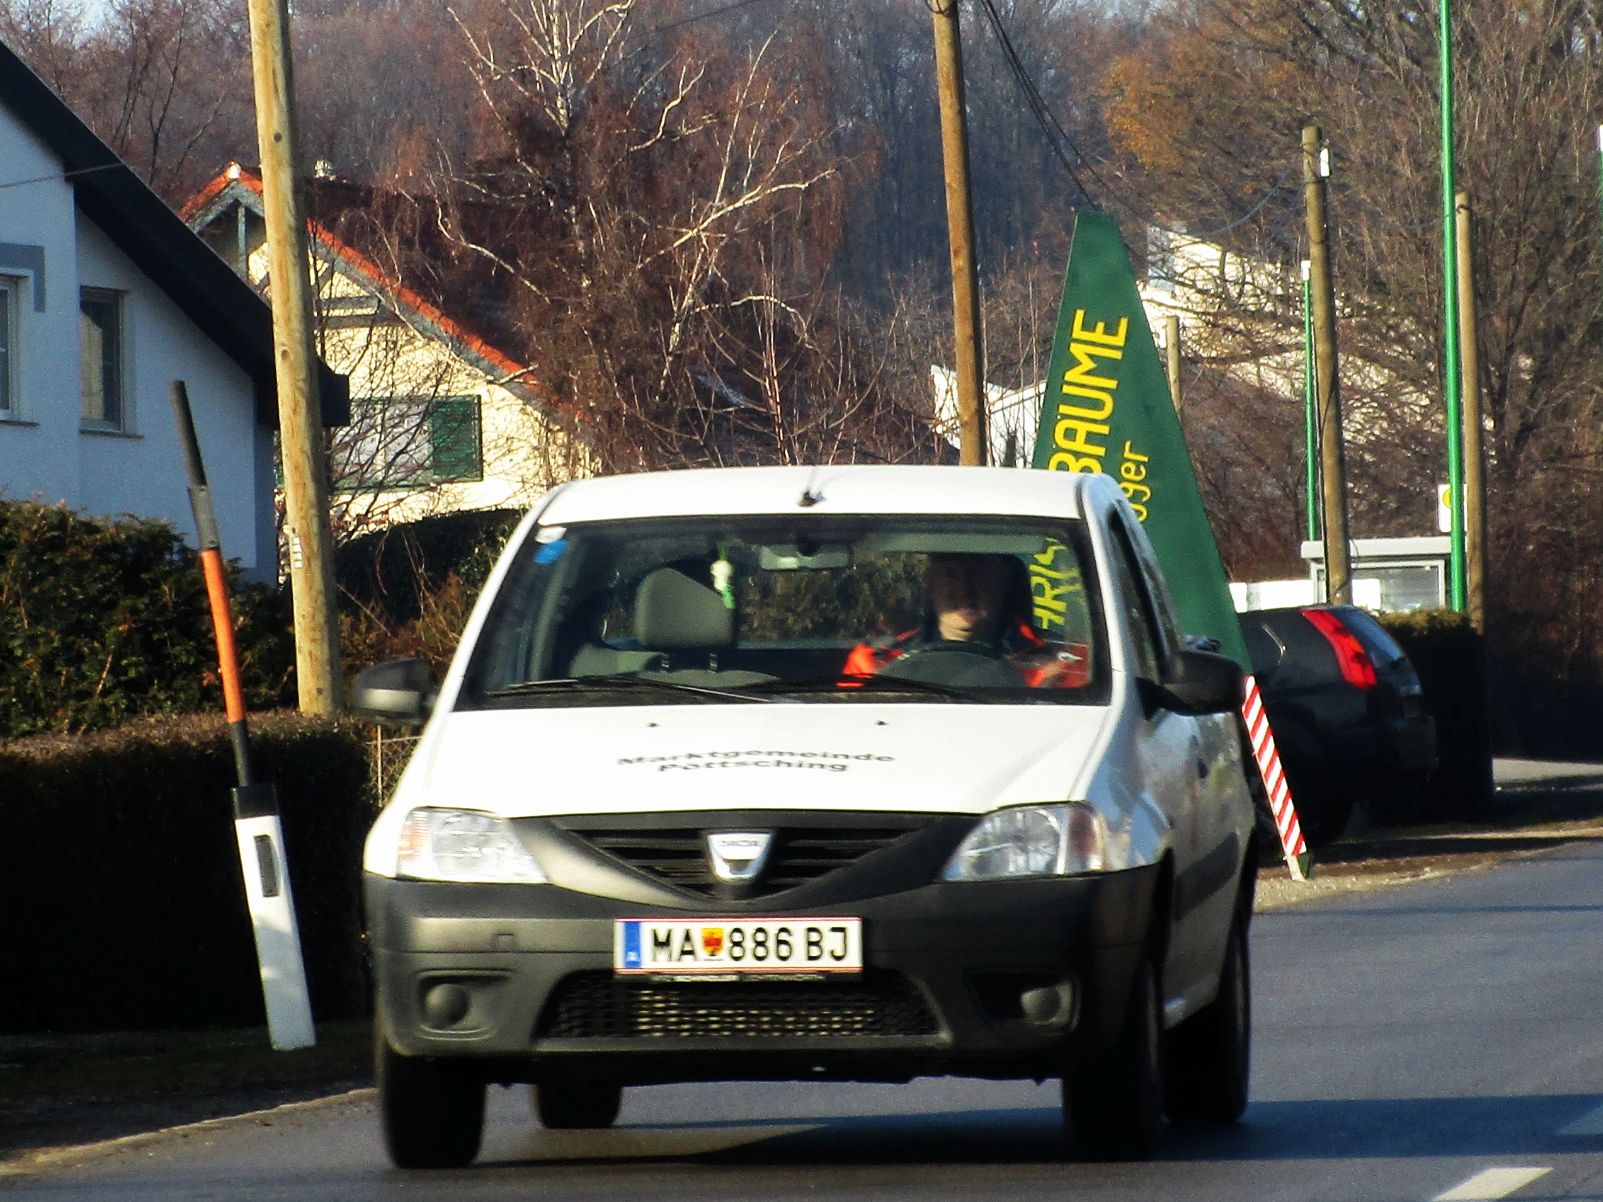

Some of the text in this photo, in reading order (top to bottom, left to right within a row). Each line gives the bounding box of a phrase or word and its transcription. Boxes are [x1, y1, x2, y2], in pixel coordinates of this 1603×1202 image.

[617, 750, 895, 765] Marktgemeinde
[651, 927, 848, 962] MA 886 BJ
